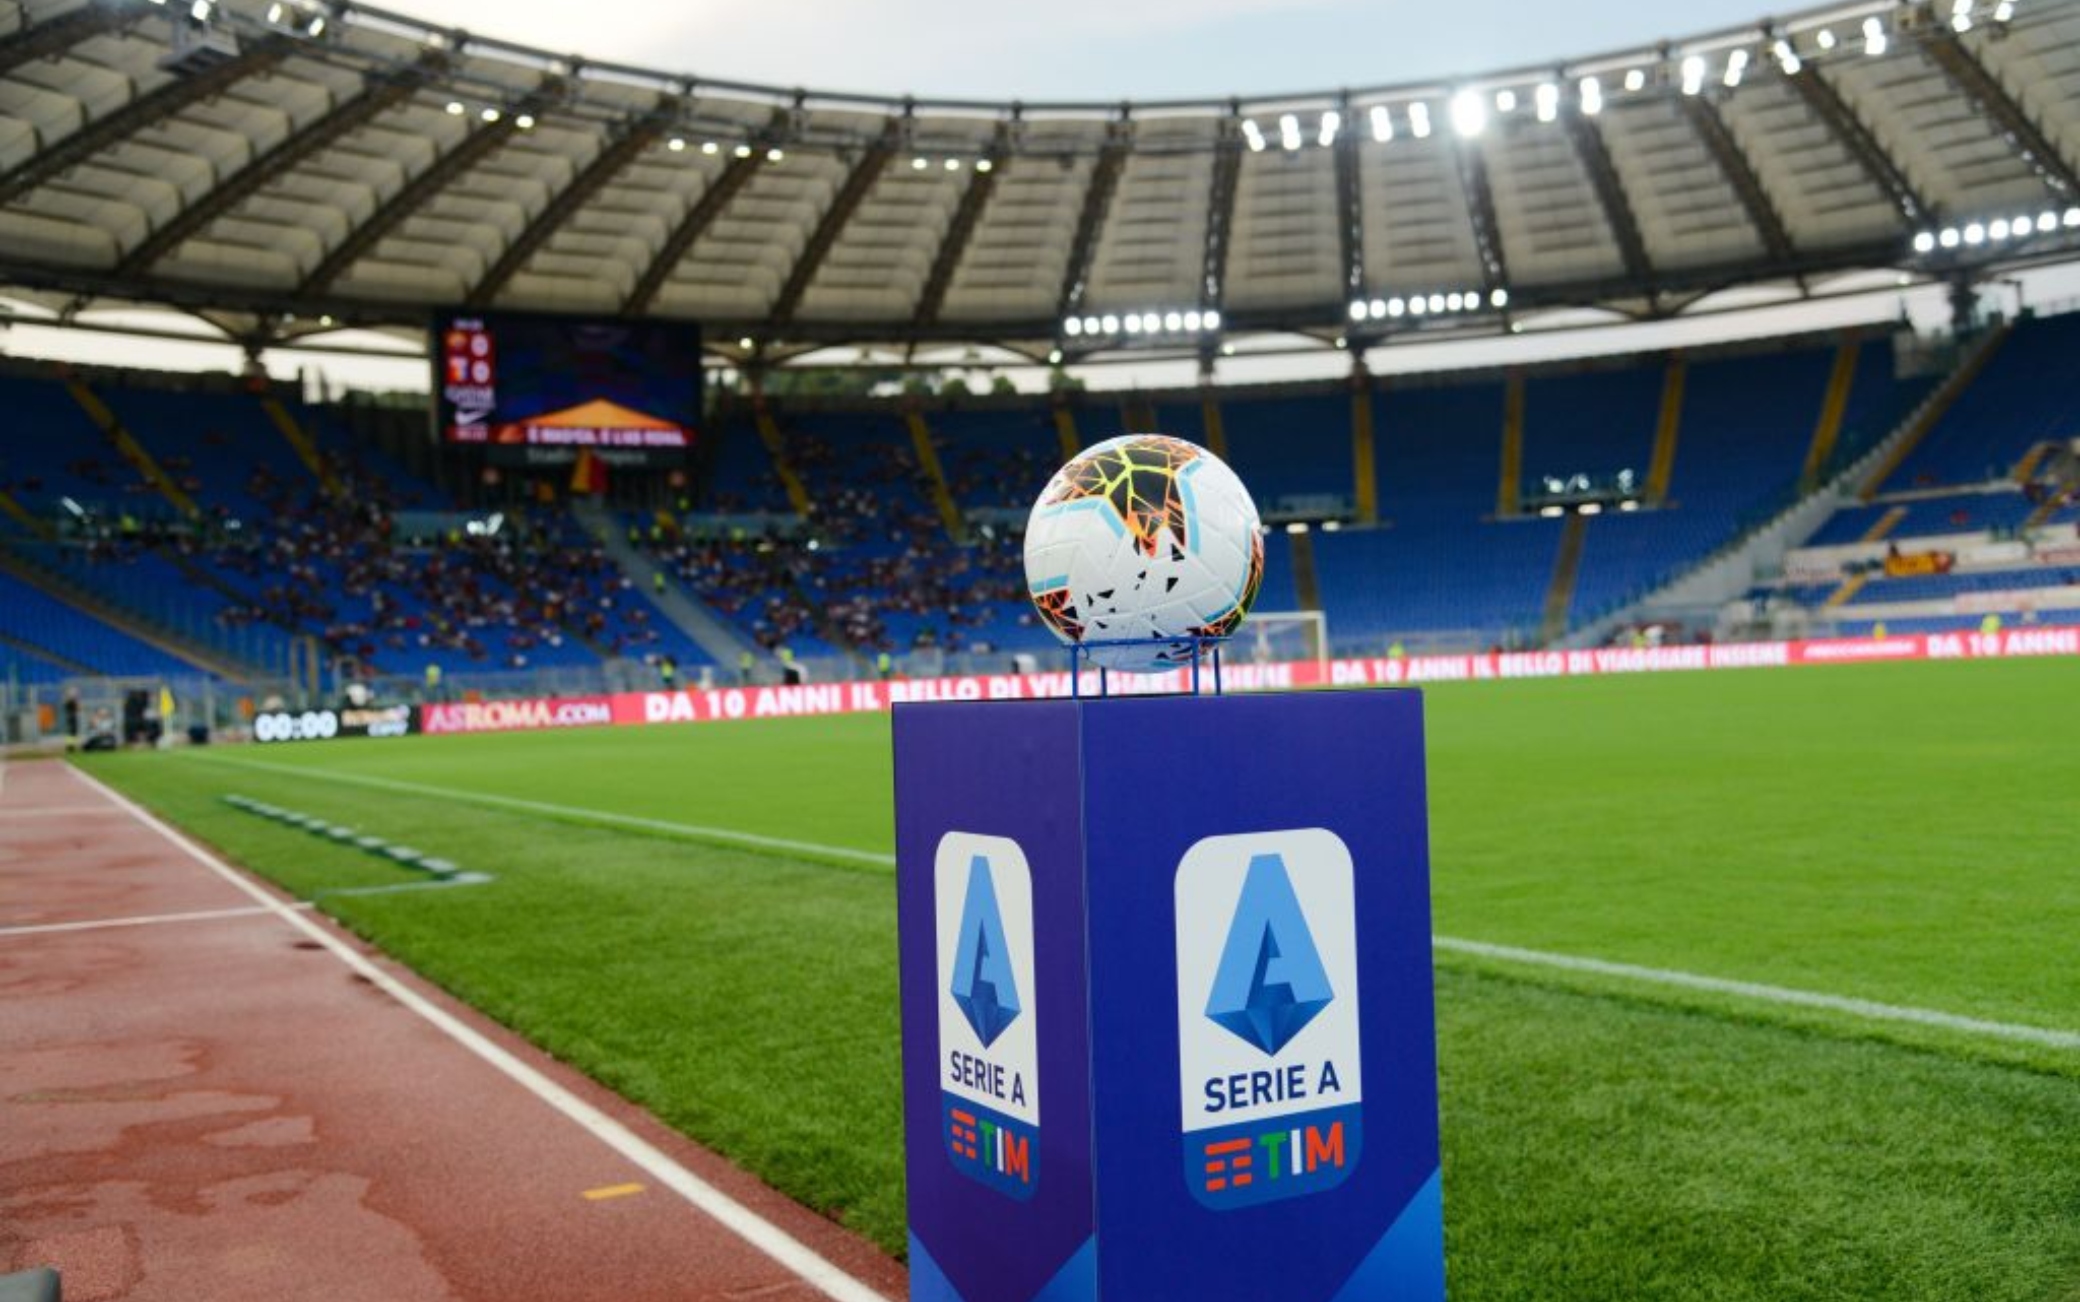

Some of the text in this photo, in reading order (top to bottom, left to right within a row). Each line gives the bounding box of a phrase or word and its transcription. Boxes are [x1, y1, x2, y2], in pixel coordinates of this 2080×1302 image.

[1331, 659, 1367, 685] DA
[1374, 658, 1399, 682] 10
[1405, 656, 1468, 682] ANNI
[1473, 655, 1496, 679] IL
[1499, 652, 1564, 677] BELLO
[1568, 650, 1594, 675] DI
[1927, 633, 1964, 658] DA
[2004, 629, 2078, 655] ANNI
[645, 693, 697, 722] DA
[705, 691, 746, 718] 10
[755, 684, 842, 716] ANNI
[852, 683, 883, 709] IL
[889, 678, 981, 702] BELLO
[989, 674, 1021, 698] DI
[254, 709, 338, 742] 00:00
[950, 1049, 1027, 1108] SERIE A
[1203, 1060, 1342, 1113] SERIE A
[978, 1127, 1029, 1182] TIM
[1259, 1120, 1345, 1181] TIM
